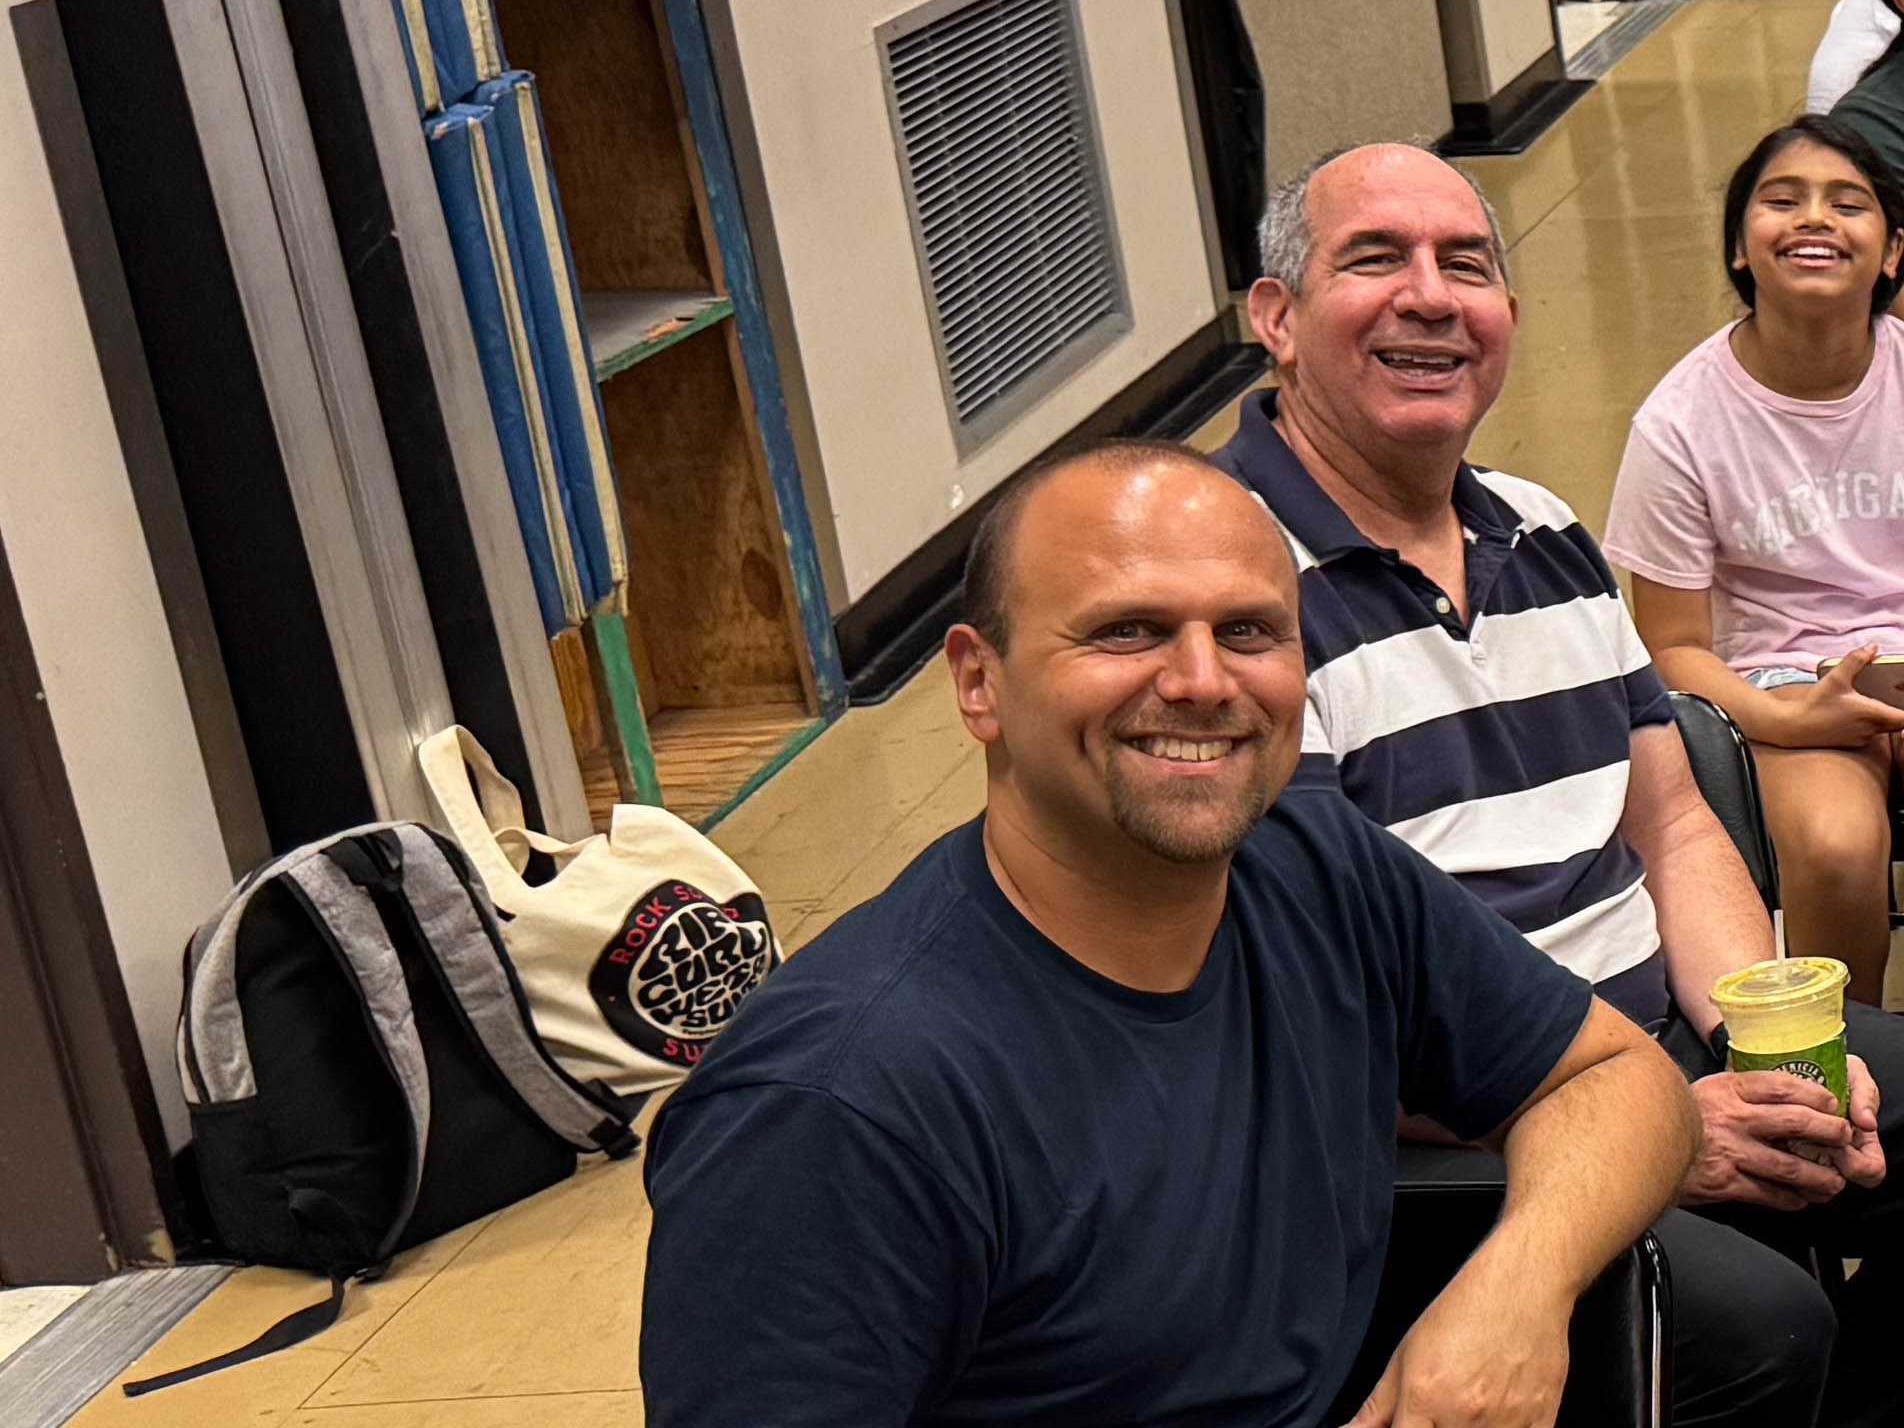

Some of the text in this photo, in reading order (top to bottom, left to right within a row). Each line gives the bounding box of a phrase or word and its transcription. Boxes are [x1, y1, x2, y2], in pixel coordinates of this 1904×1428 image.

[608, 896, 673, 965] ROCK
[638, 907, 730, 981] RIP
[637, 927, 768, 1010] CURL
